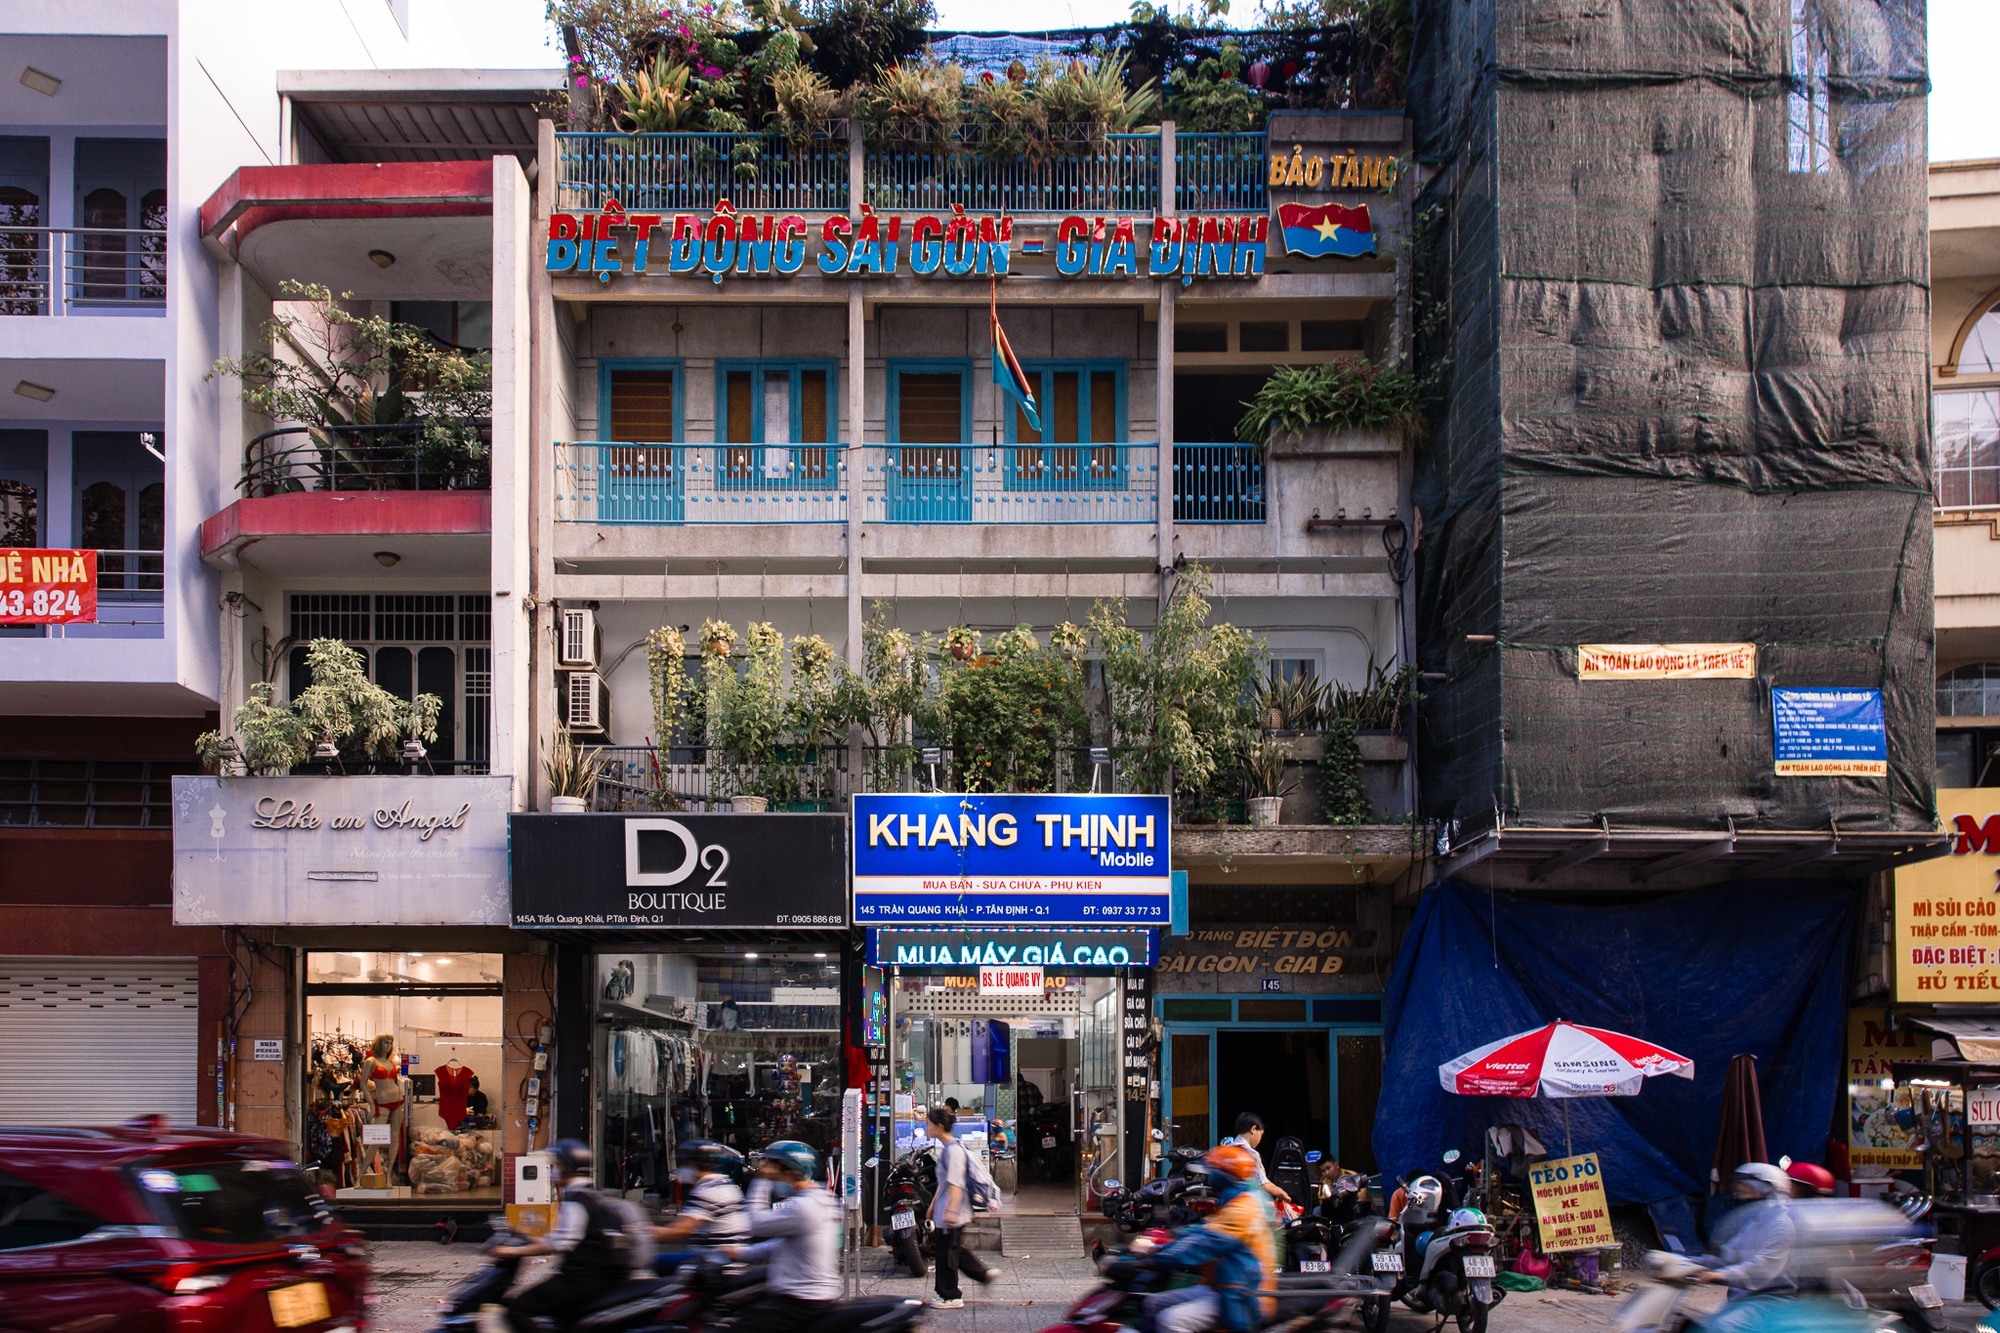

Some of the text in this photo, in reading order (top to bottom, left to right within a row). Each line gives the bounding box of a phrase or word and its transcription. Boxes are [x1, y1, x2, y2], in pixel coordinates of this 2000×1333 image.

[1269, 144, 1398, 188] BẢO TÀNG
[545, 198, 662, 287] BIỆT
[668, 197, 808, 287] ĐỘNG
[817, 203, 901, 277] SÀI
[908, 203, 1012, 278] GÒN
[1056, 215, 1137, 278] GIA
[1148, 215, 1269, 286] ĐỊNH
[31, 551, 88, 583] NHÀ
[1584, 648, 1749, 675] AN TOÀN LAO ĐỘNG LÀ TRÊN HẾT
[1781, 764, 1790, 772] AN
[1792, 762, 1809, 772] TOÀN
[1811, 764, 1823, 772] LAO
[1824, 763, 1842, 773] ĐỘNG
[1852, 763, 1868, 772] TRÊN
[1869, 762, 1881, 772] HẾT
[250, 796, 473, 841] Like an Angel
[868, 813, 1155, 856] KHANG THỊNH
[1100, 851, 1155, 867] Mobile
[922, 880, 947, 889] MUA
[1009, 879, 1042, 889] CHỮA
[1050, 881, 1073, 891] PHỤ
[1076, 879, 1102, 891] KIỆN
[628, 892, 727, 913] BOUTIQUE
[1913, 897, 1996, 917] MÌ SỦI CẢO
[860, 906, 875, 915] 145
[908, 906, 941, 915] QUANG
[1005, 906, 1028, 917] ĐỊNH
[1035, 906, 1050, 915] Q.1
[1083, 906, 1161, 916] ĐT: 0937 33 77 33
[516, 915, 536, 923] 145A
[557, 914, 583, 924] Quang
[606, 914, 628, 923] P.Tân
[651, 915, 664, 923] Q.1
[776, 915, 842, 924] ĐT: 0905 886 618
[1910, 922, 1939, 940] THẬP
[1941, 921, 1967, 937] CẨM
[1197, 927, 1235, 941] TÀNG
[1235, 925, 1299, 953] BIỆT
[897, 941, 1129, 964] MUA MÁY GIÁ CAO
[1912, 944, 1987, 968] ĐẶC BIỆT
[1152, 950, 1198, 973] SÀI
[1197, 951, 1259, 974] GÒN
[1274, 955, 1319, 974] GIA
[944, 976, 1067, 989] MUA AO
[982, 972, 995, 987] BS.
[1006, 972, 1030, 989] QUANG
[1031, 972, 1041, 987] VY
[1127, 979, 1137, 990] MUA
[1262, 980, 1281, 991] 145
[1917, 970, 1948, 990] HỦ
[1126, 997, 1146, 1010] GIÁ CAO
[1126, 1035, 1135, 1049] CÀI
[1485, 1062, 1531, 1070] viettel
[1554, 1060, 1618, 1068] SAMSUNG
[1125, 1089, 1146, 1102] 145
[1603, 1083, 1616, 1093] 5G
[1971, 1091, 1993, 1122] SỦI
[1852, 1153, 1862, 1165] MÌ
[1531, 1158, 1598, 1185] TÈO PÔ
[1536, 1183, 1579, 1199] MÓC PÔ LÀM
[1561, 1198, 1580, 1209] XE
[1555, 1224, 1597, 1238] INOX THAU
[1546, 1234, 1610, 1249] ĐT: 0902 719 507
